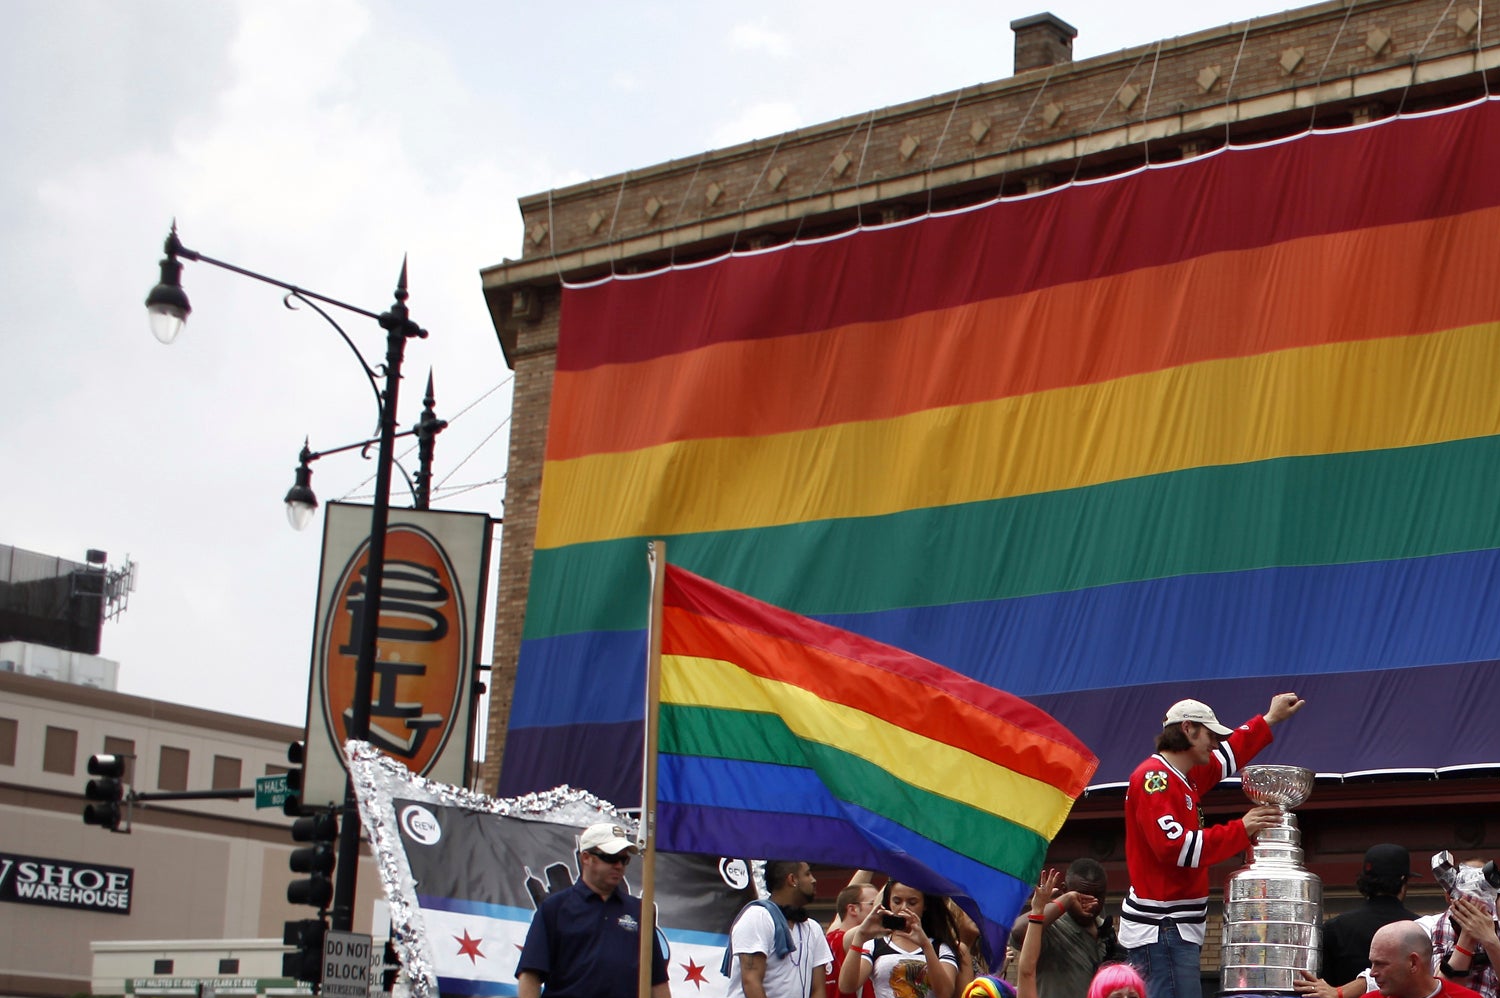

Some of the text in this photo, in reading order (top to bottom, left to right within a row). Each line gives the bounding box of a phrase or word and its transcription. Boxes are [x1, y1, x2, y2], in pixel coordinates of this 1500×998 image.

[264, 779, 288, 795] HALS
[1157, 815, 1184, 840] 5
[17, 861, 128, 893] SHOE
[17, 882, 128, 909] WAREHOUSE
[326, 940, 369, 958] DO NOT
[326, 962, 367, 981] BLOCK
[369, 973, 384, 986] BLO
[323, 983, 366, 996] INTERSECTION
